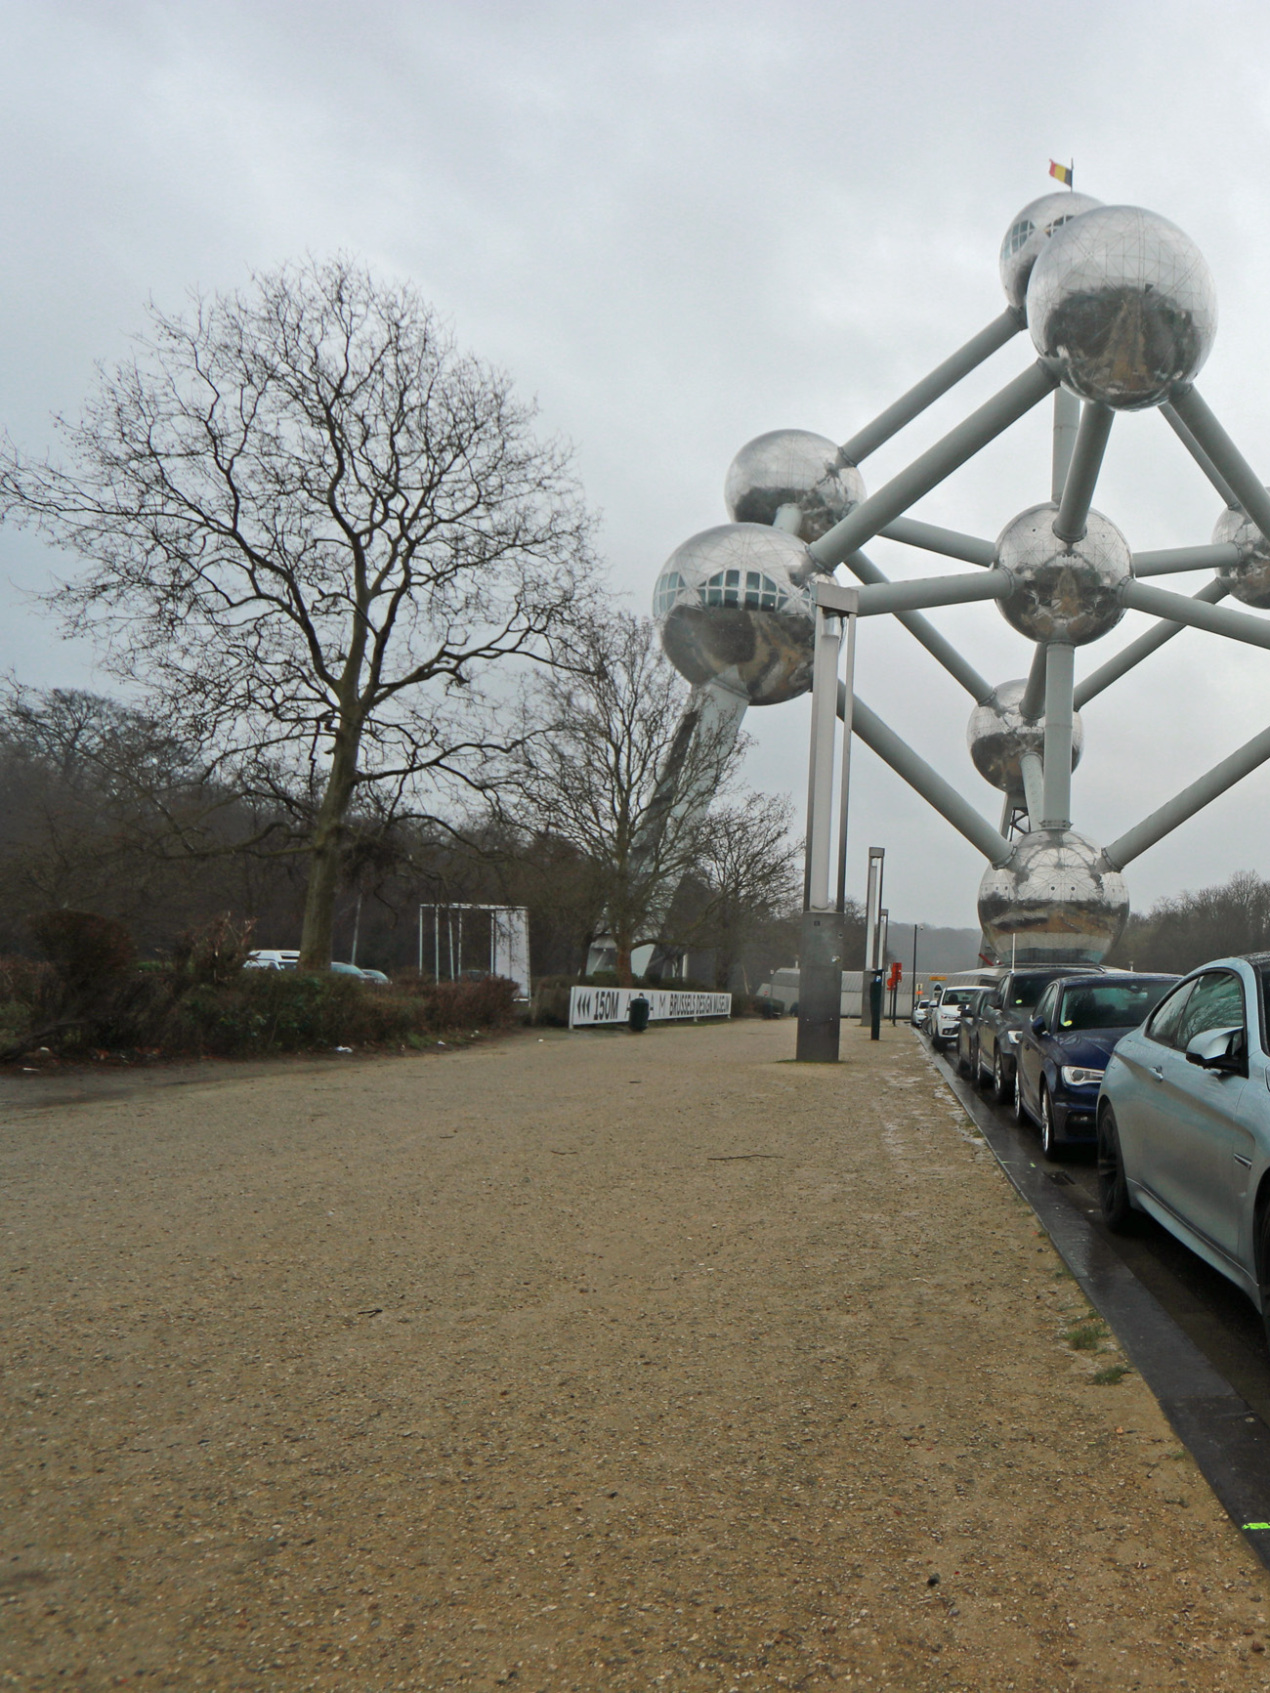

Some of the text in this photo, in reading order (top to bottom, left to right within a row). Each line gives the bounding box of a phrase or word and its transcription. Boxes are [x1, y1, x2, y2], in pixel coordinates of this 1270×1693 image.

[593, 991, 619, 1020] 150M
[669, 993, 696, 1016] BRUSSELS
[696, 994, 713, 1015] DESIGN
[713, 995, 730, 1014] MUSEUM
